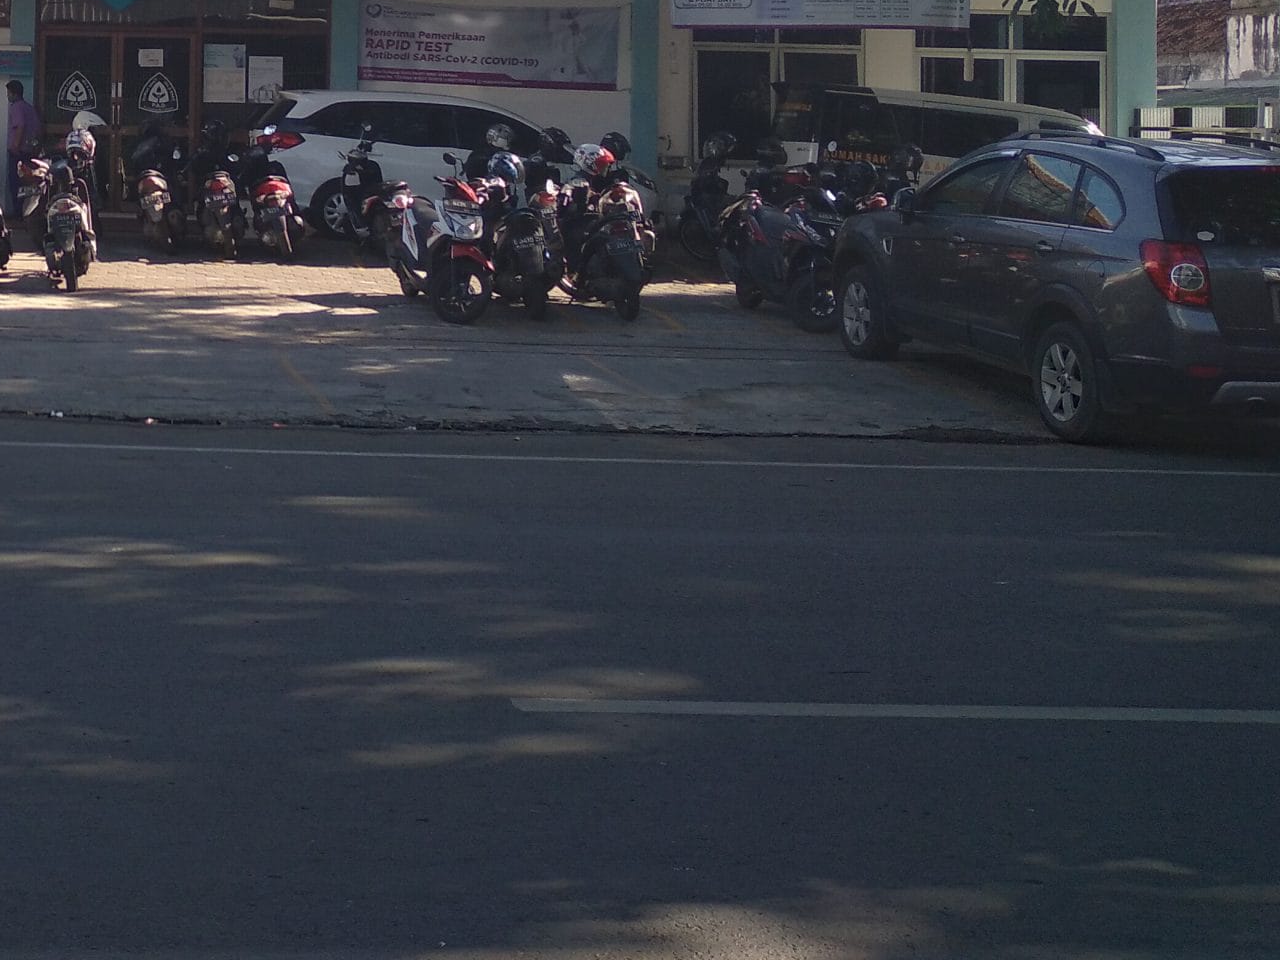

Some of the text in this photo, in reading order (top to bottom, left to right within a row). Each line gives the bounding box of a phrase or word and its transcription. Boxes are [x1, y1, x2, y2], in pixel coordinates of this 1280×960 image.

[365, 27, 486, 42] Menerima Pemeriksaan
[365, 38, 452, 53] RAPID TEST
[366, 51, 539, 68] Antibodi SARS-CoV-2 (COVID-19)
